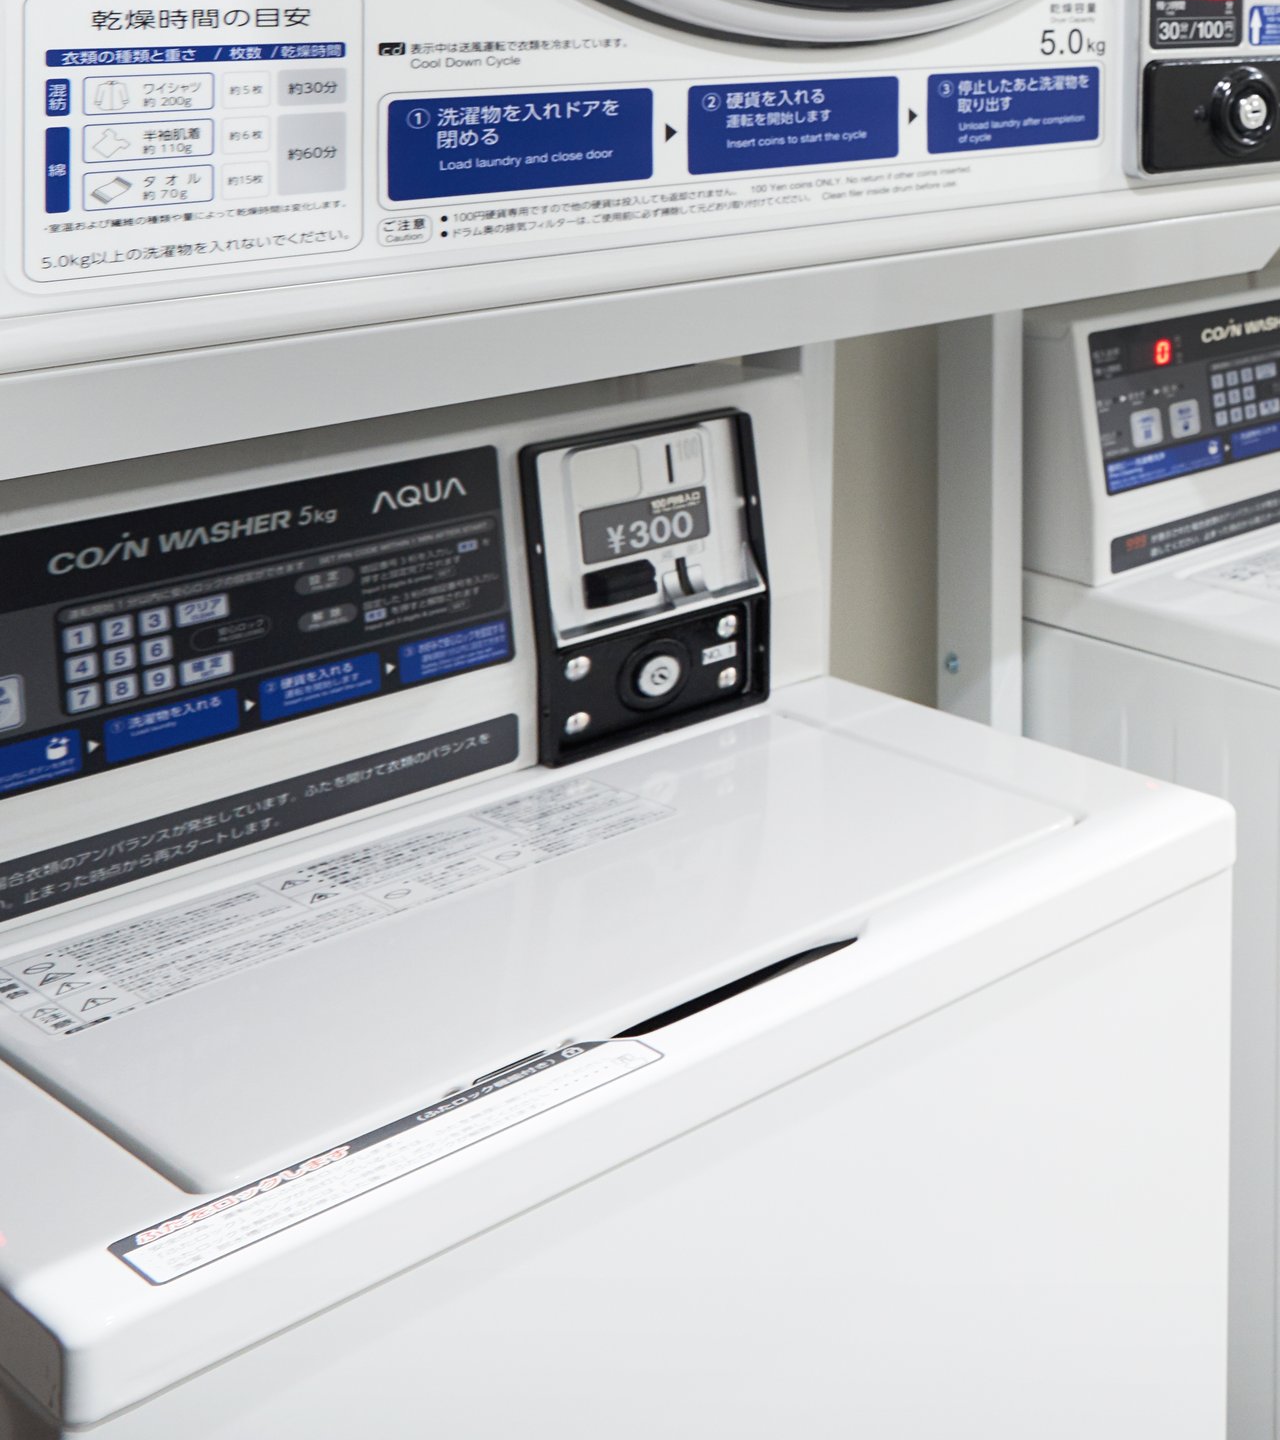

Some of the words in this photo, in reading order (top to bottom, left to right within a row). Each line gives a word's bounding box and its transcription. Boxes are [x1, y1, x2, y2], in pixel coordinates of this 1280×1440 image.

[91, 8, 311, 31] 乾燥時間の目安
[61, 49, 196, 65] 衣類の種類と重さ
[229, 47, 262, 60] 枚数
[410, 38, 628, 55] 表示中は送風運転で衣類を冷ましています。
[410, 57, 442, 70] Cool
[445, 56, 482, 68] Down
[487, 55, 521, 68] Cycle
[143, 82, 201, 95] ワイシャツ
[288, 80, 338, 95] 約30分
[958, 74, 1090, 96] 停止したあと洗濯物を
[48, 84, 67, 111] 混紡
[726, 89, 826, 110] 硬貨を入れる
[957, 96, 1012, 114] 取り出す
[437, 99, 620, 127] 洗濯物を入れドアを
[726, 109, 831, 129] 運転を開始します
[958, 121, 989, 131] Unload
[991, 119, 1020, 129] laundry
[1022, 117, 1041, 126] after
[1042, 114, 1085, 126] completion
[143, 127, 200, 142] 半袖肌着
[436, 128, 500, 150] 閉める
[726, 137, 756, 148] Insert
[759, 136, 785, 147] coins
[788, 135, 798, 145] to
[800, 133, 822, 144] start
[824, 131, 840, 142] the
[842, 129, 867, 143] cycle
[958, 134, 967, 143] of
[969, 133, 992, 143] cycle
[288, 146, 337, 160] 約60分
[439, 158, 472, 171] Load
[476, 155, 522, 170] laundry
[525, 153, 548, 164] and
[551, 150, 583, 162] close
[586, 148, 613, 159] door
[770, 183, 787, 192] Yen
[790, 181, 813, 189] coins
[821, 191, 847, 200] Clean
[385, 232, 423, 243] Caution
[41, 228, 350, 270] 5.0kg以上の洗濯物を入れないでください。
[1155, 339, 1172, 365] 0
[158, 510, 291, 554] WASHER
[371, 476, 467, 514] AQUA
[606, 511, 694, 554] ¥300
[183, 598, 222, 615] クリア
[74, 631, 83, 644] 1
[112, 622, 124, 636] 2
[150, 614, 161, 628] 3
[75, 661, 88, 674] 4
[114, 652, 126, 666] 5
[152, 643, 163, 657] 6
[78, 690, 90, 705] 7
[116, 681, 129, 696] 8
[153, 672, 165, 687] 9
